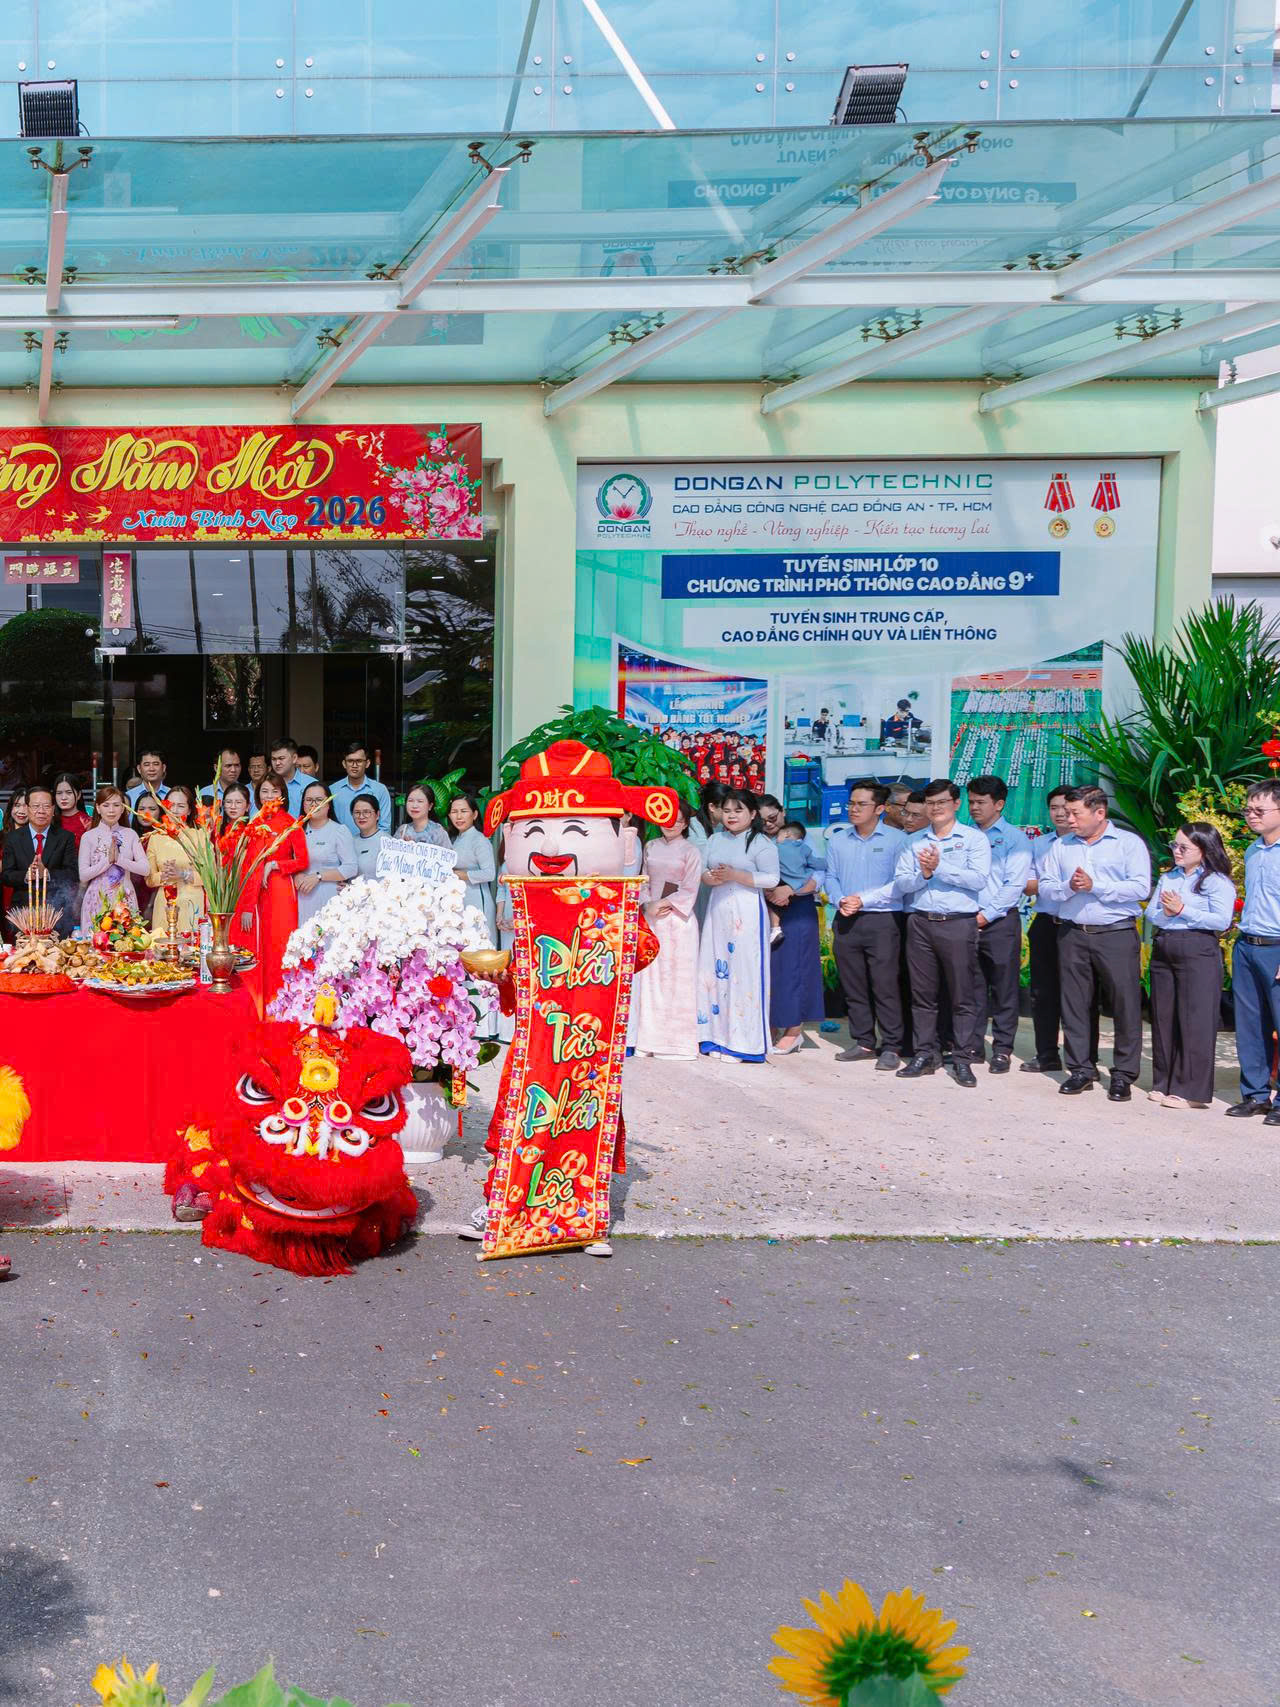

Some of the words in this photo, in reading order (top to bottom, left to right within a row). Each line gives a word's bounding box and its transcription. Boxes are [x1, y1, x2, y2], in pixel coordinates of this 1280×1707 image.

[70, 432, 200, 495] Năm
[206, 430, 335, 501] Mới
[674, 475, 783, 491] DONGAN
[793, 474, 992, 489] POLYTECHNIC
[122, 509, 187, 530] Xuân
[190, 509, 245, 529] Bính
[246, 509, 298, 532] Ngọ
[303, 495, 388, 527] 2026
[672, 504, 700, 514] CAO
[704, 498, 742, 514] ĐẲNG
[746, 501, 784, 513] CÔNG
[789, 500, 827, 516] NGHỆ
[831, 503, 858, 512] CAO
[863, 497, 902, 512] ĐỒNG
[906, 502, 925, 512] AN
[938, 502, 958, 512] TP.
[963, 502, 992, 512] HCM
[674, 520, 713, 538] Thạo
[717, 522, 748, 542] nghề
[806, 519, 849, 542] nghiệp
[863, 520, 899, 538] Kiến
[904, 524, 925, 537] tạo
[783, 555, 840, 573] TUYỂN
[843, 558, 882, 572] SINH
[884, 554, 917, 572] LỚP
[921, 558, 938, 572] 10
[687, 577, 760, 593] CHƯƠNG
[763, 574, 814, 592] TRÌNH
[815, 574, 852, 592] PHỔ
[854, 574, 914, 591] THÔNG
[917, 577, 955, 591] CAO
[955, 571, 1007, 591] ĐẲNG
[770, 609, 820, 624] TUYỂN
[823, 612, 857, 624] SINH
[860, 612, 910, 623] TRUNG
[913, 608, 949, 626] CẤP,
[722, 631, 754, 642] CAO
[756, 627, 800, 642] ĐẲNG
[803, 626, 849, 642] CHÍNH
[852, 630, 883, 642] QUY
[887, 625, 907, 640] VÀ
[911, 626, 941, 640] LIÊN
[944, 626, 997, 640] THÔNG
[543, 788, 563, 809] 财
[533, 927, 616, 991] Phát
[546, 1011, 597, 1064] Tài
[521, 1079, 600, 1139] Phát
[525, 1161, 576, 1209] Lộc
